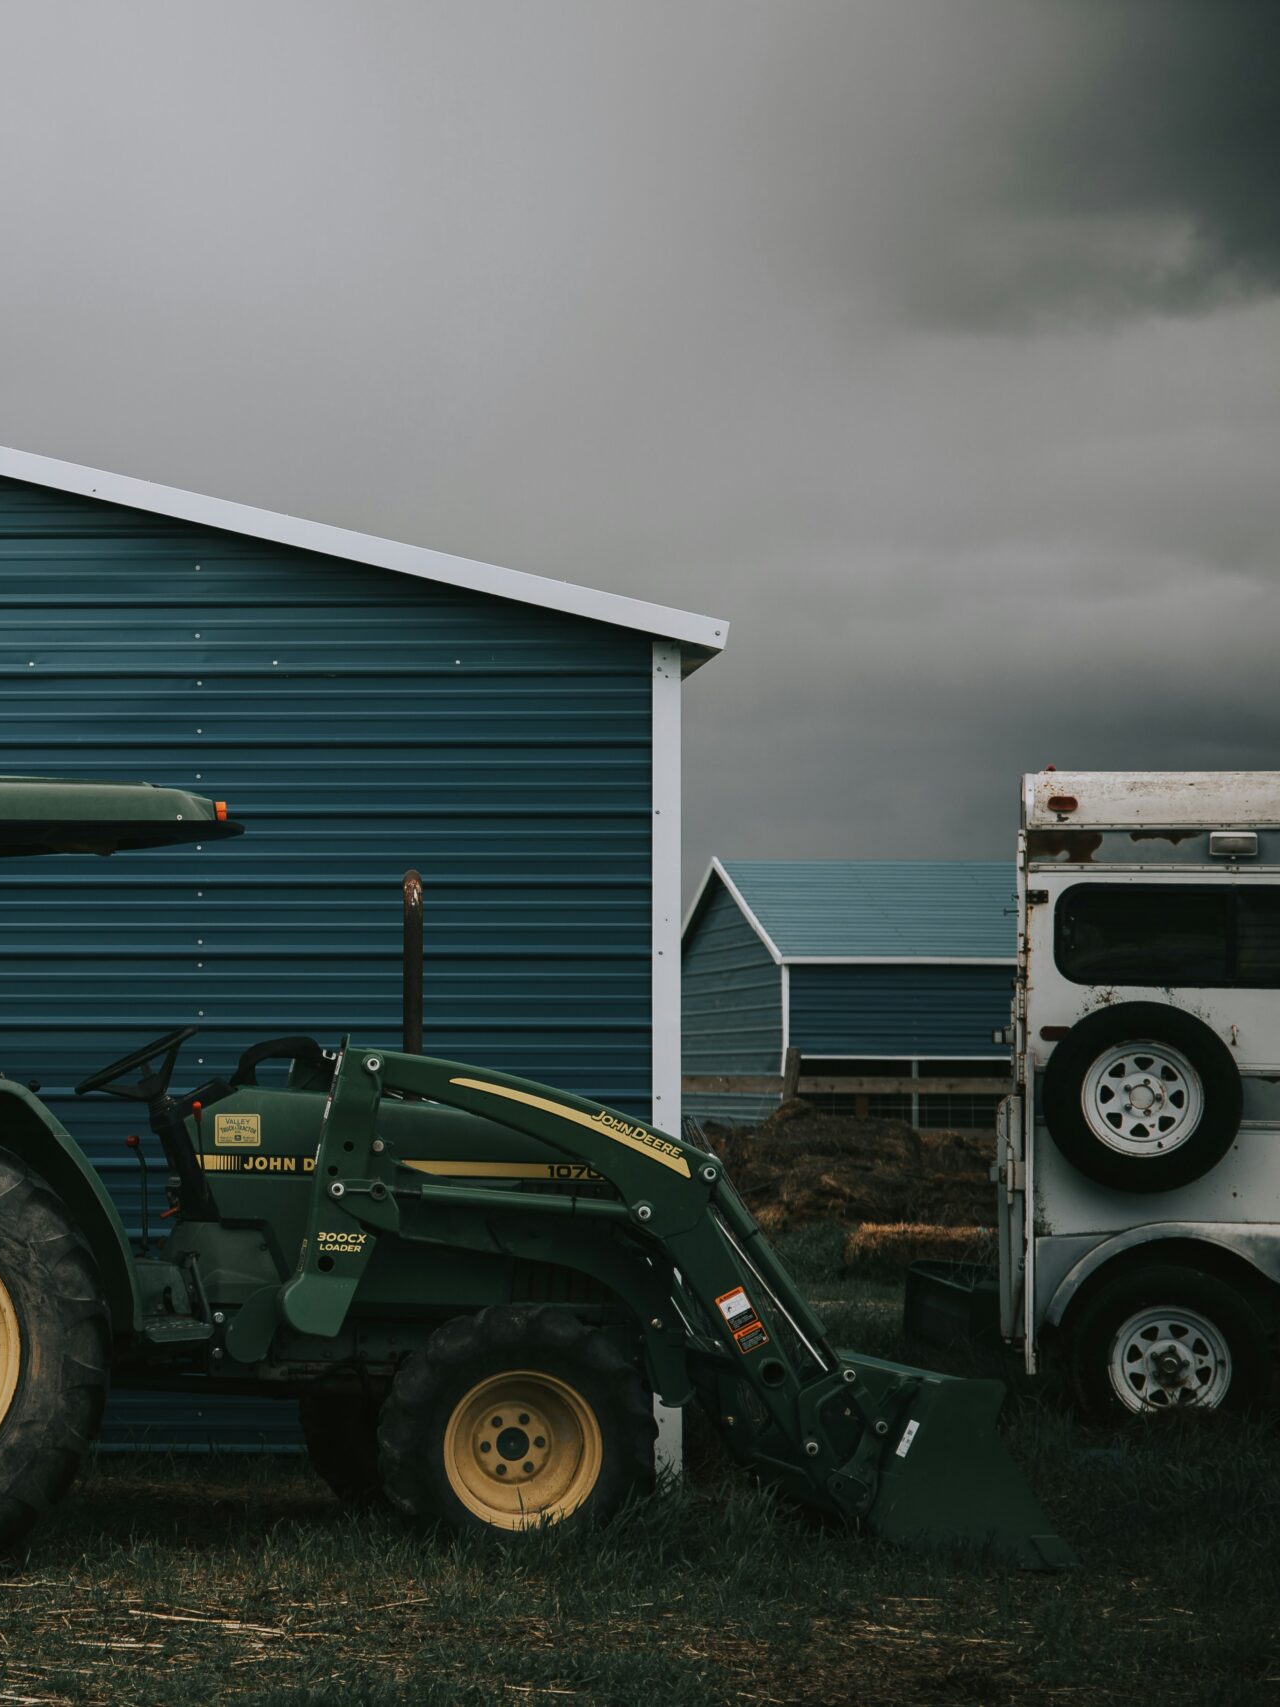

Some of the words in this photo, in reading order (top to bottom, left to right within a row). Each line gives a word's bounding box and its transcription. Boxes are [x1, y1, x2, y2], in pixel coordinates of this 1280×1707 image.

[243, 1156, 296, 1171] JOHN
[303, 1157, 315, 1171] D
[317, 1232, 367, 1244] 300CX
[319, 1243, 362, 1253] LOADER
